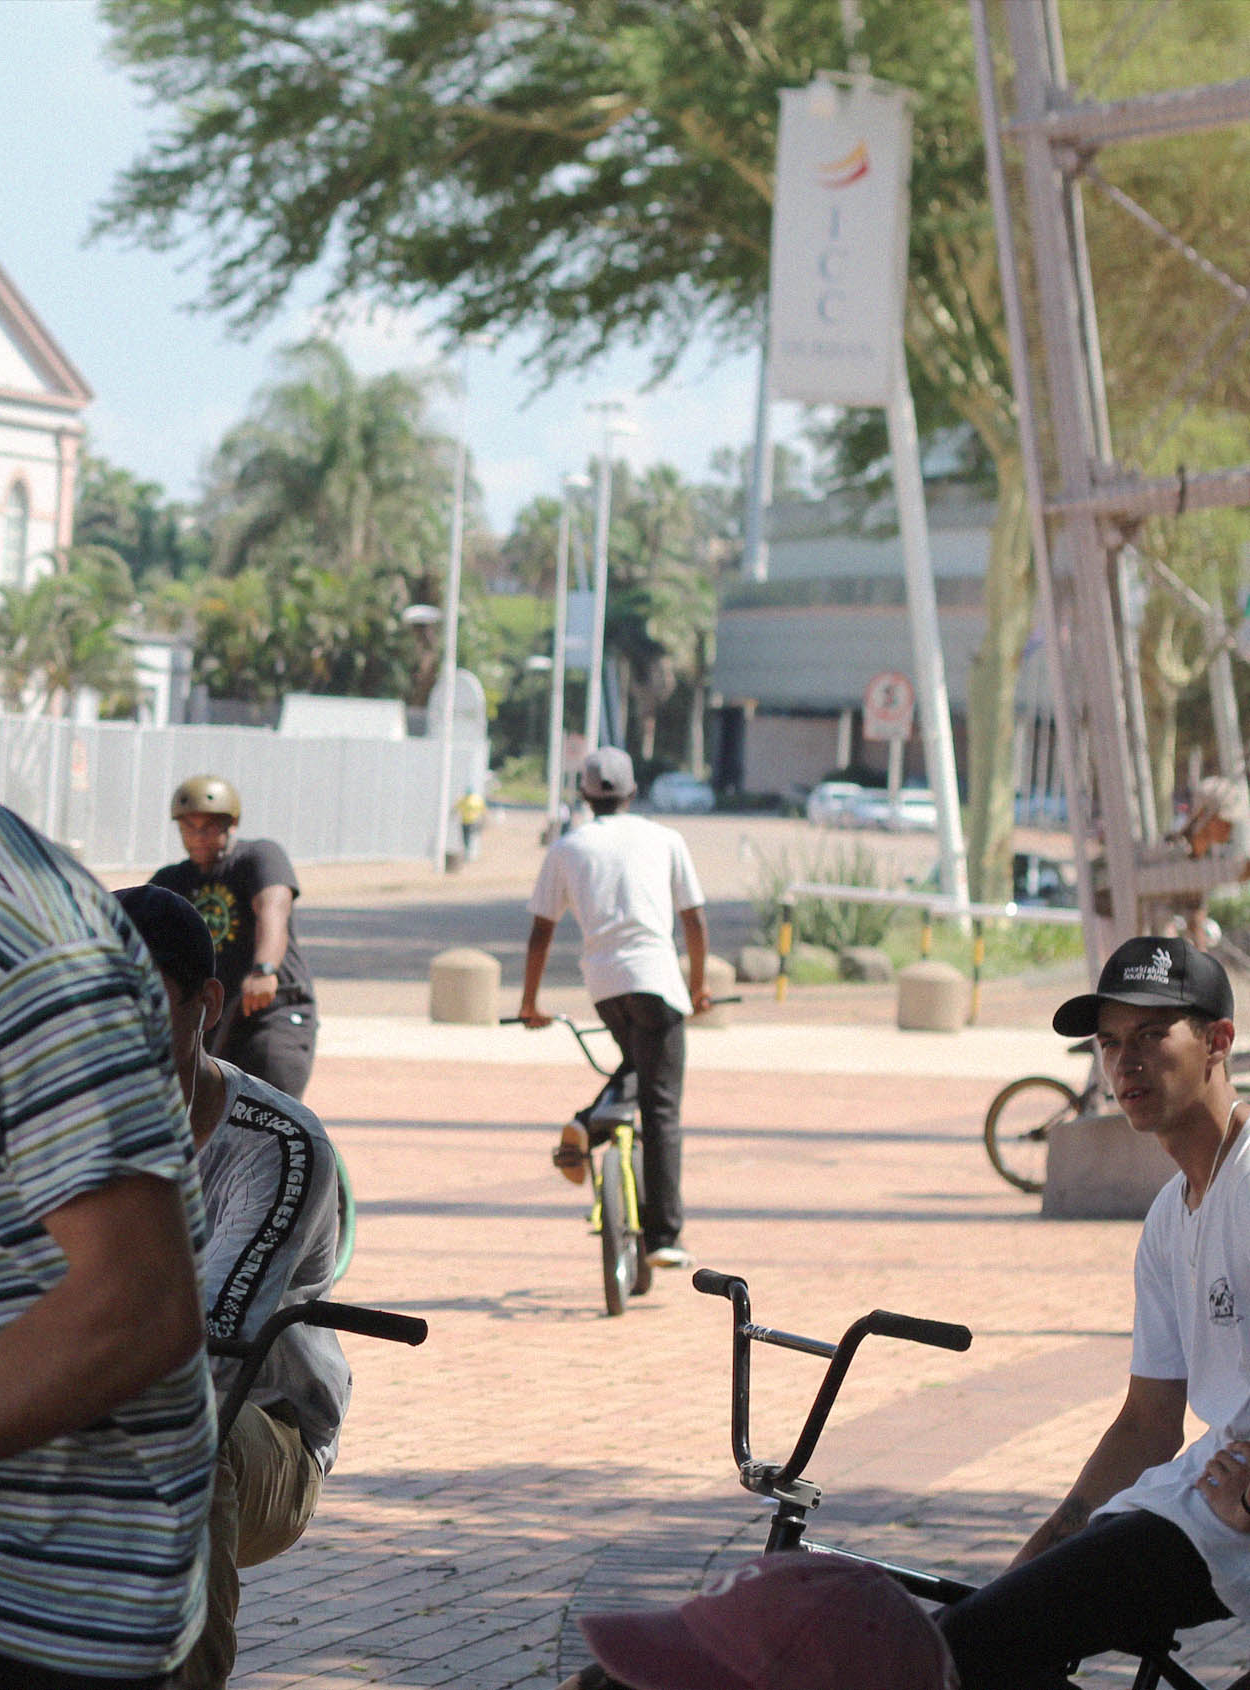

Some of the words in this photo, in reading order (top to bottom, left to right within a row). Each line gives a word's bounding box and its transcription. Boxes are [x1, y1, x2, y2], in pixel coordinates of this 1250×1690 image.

[265, 1116, 300, 1136] LOS
[272, 1140, 307, 1229] ANGELES
[227, 1241, 274, 1302] BERLIN
